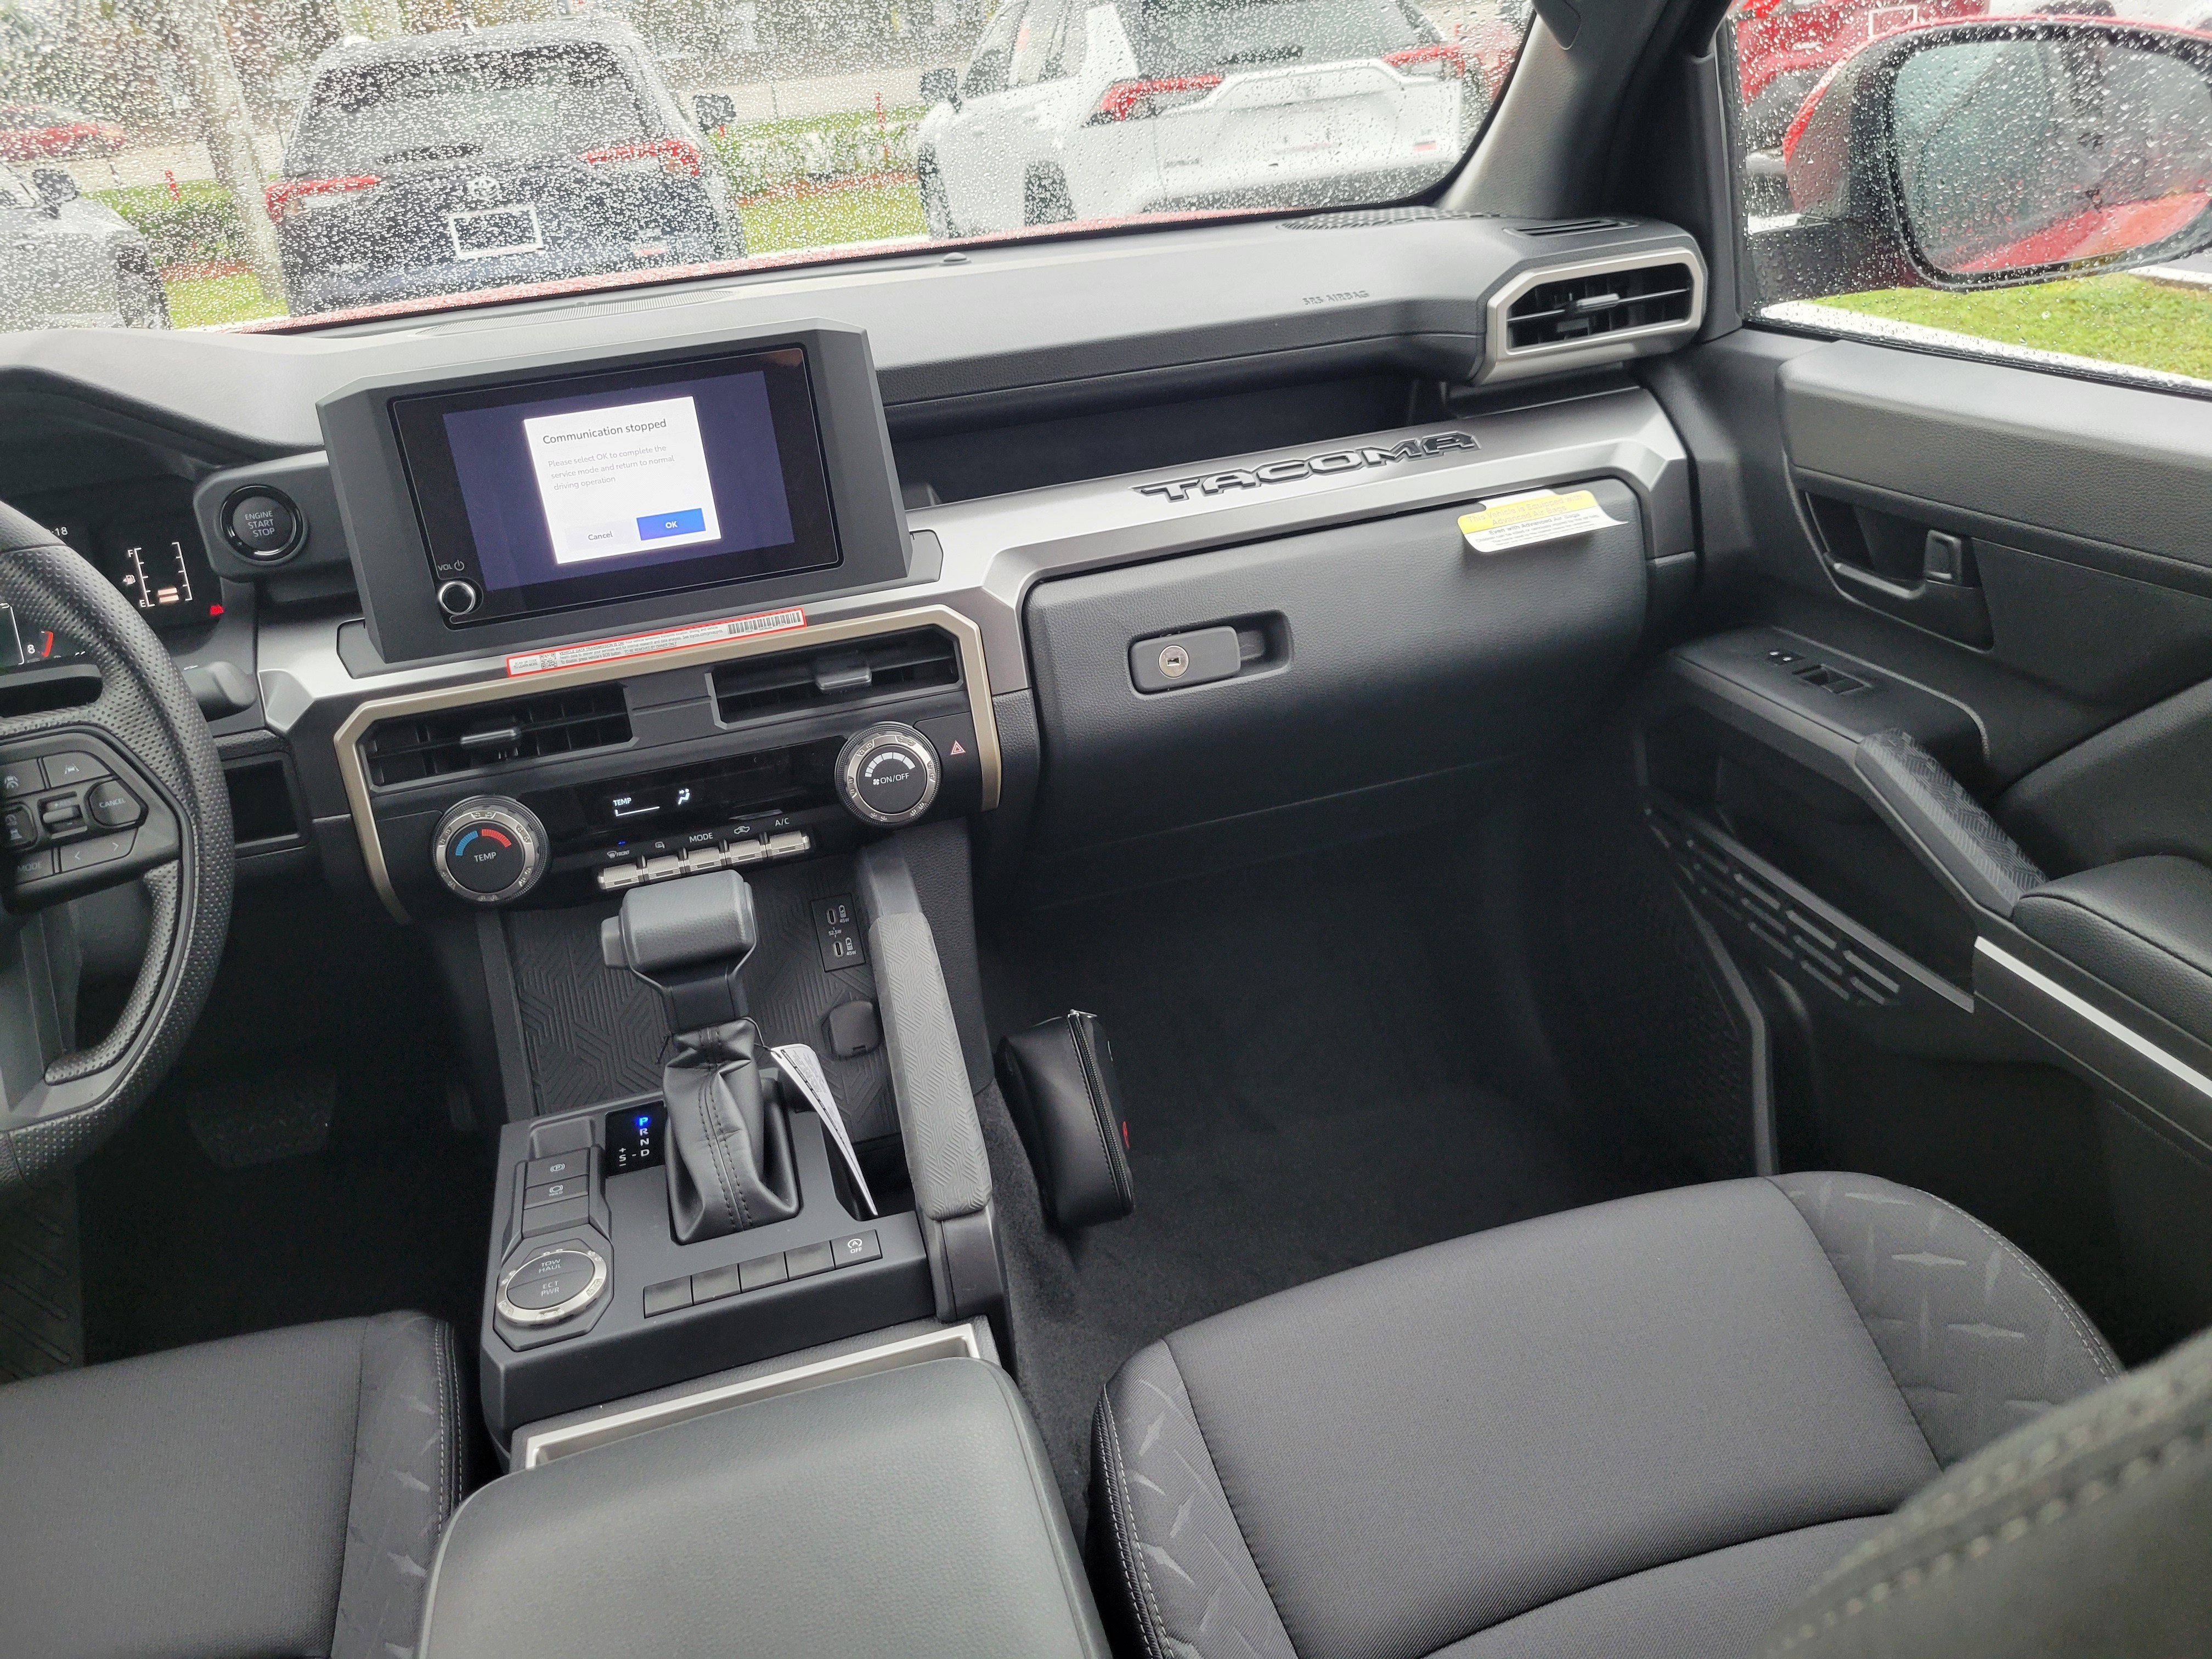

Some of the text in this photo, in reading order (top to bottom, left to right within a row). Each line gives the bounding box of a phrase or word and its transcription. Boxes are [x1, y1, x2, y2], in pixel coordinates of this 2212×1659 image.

[1325, 290, 1370, 302] AIRBAG
[543, 418, 667, 444] Communication stopped
[548, 459, 572, 467] Please
[574, 455, 595, 465] select
[596, 453, 608, 461] OK
[619, 447, 653, 458] complete
[551, 471, 576, 479] service
[578, 466, 599, 475] mode
[601, 464, 615, 472] and
[616, 461, 638, 470] return
[648, 455, 675, 465] normal
[1132, 431, 1481, 502] TACOMA
[554, 476, 616, 490] driving operation
[1486, 508, 1516, 518] Vehicle
[1526, 498, 1564, 510] Equipped
[245, 510, 274, 521] ENGINE
[1492, 512, 1532, 526] Advanced
[1546, 506, 1567, 514] Bags
[247, 518, 274, 529] START
[665, 520, 678, 529] OK
[1521, 518, 1552, 528] Advanced
[252, 527, 275, 537] STOP
[588, 531, 613, 540] Cancel
[127, 549, 134, 558] F
[139, 599, 146, 608] E
[27, 644, 36, 654] 8
[880, 772, 910, 784] ON/OFF
[99, 797, 126, 808] CANCEL
[613, 797, 631, 806] TEMP
[775, 817, 790, 827] A/C
[689, 832, 714, 843] MODE
[473, 851, 496, 862] TEMP
[639, 1117, 648, 1126] P
[640, 1127, 649, 1136] R
[640, 1137, 650, 1147] N
[619, 1149, 650, 1162] S D
[539, 1263, 562, 1274] HAUL
[541, 1259, 561, 1267] TOW
[543, 1280, 560, 1289] ECT
[541, 1286, 560, 1297] PWR
